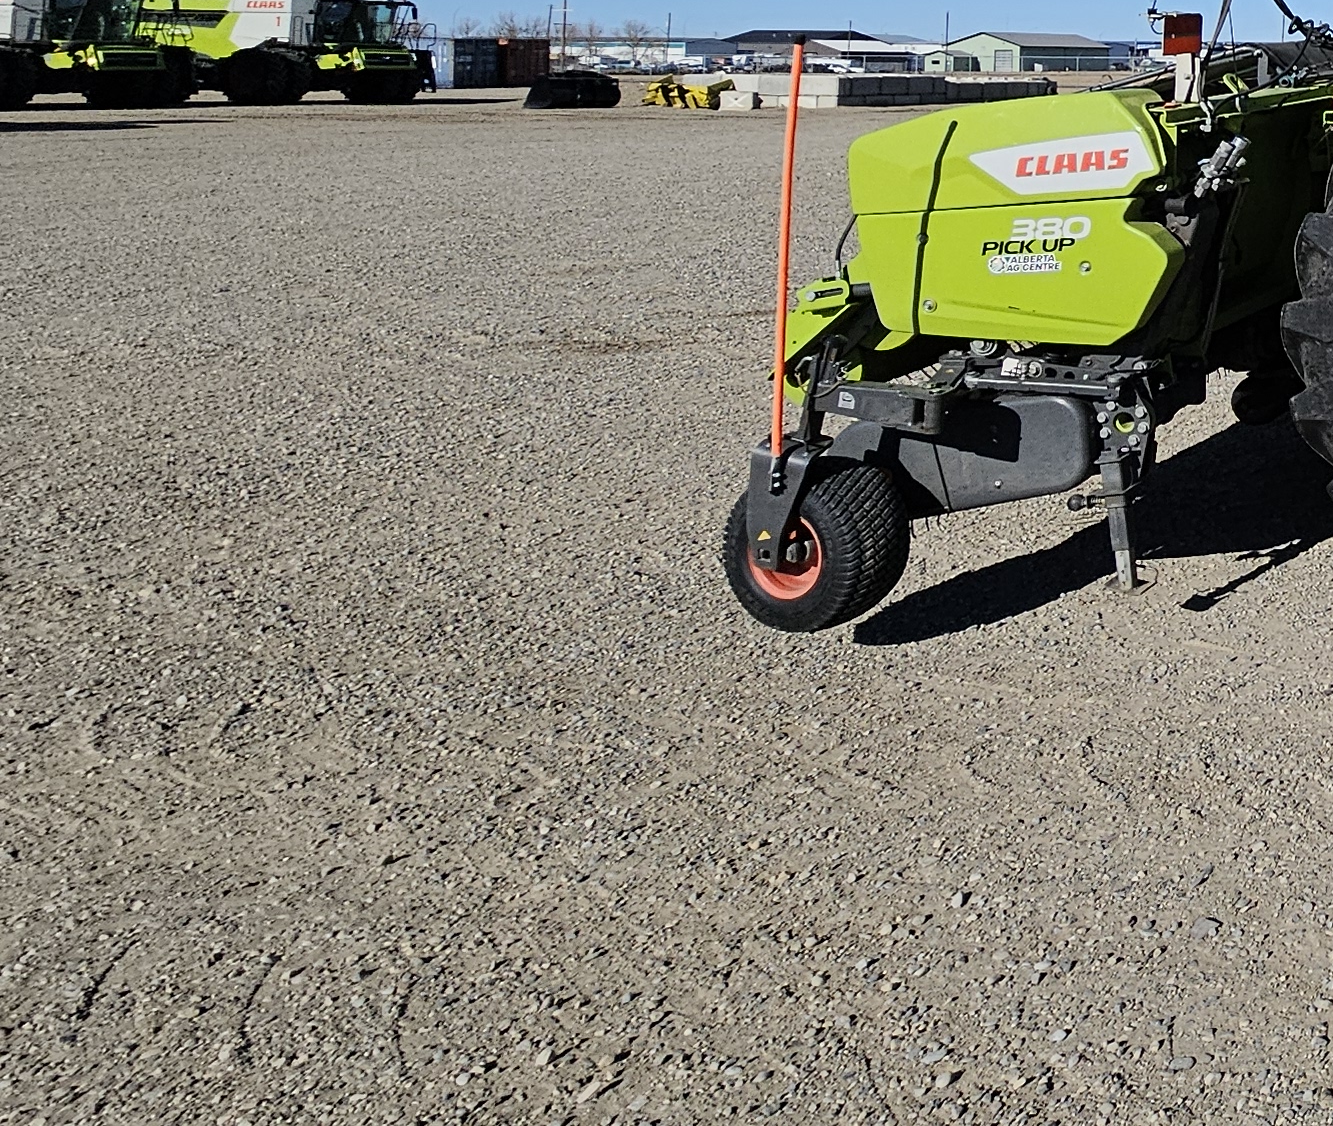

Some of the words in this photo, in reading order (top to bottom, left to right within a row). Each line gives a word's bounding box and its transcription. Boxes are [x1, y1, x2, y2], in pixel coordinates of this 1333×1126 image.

[246, 0, 286, 10] CLAAS
[275, 16, 281, 27] 1
[1015, 148, 1130, 178] CLAAS
[1011, 216, 1092, 241] 380
[981, 239, 1037, 256] PICK
[1042, 237, 1076, 252] UP
[1010, 254, 1056, 264] ALBERTA
[1006, 264, 1022, 273] AG
[1022, 262, 1061, 272] CENTRE
